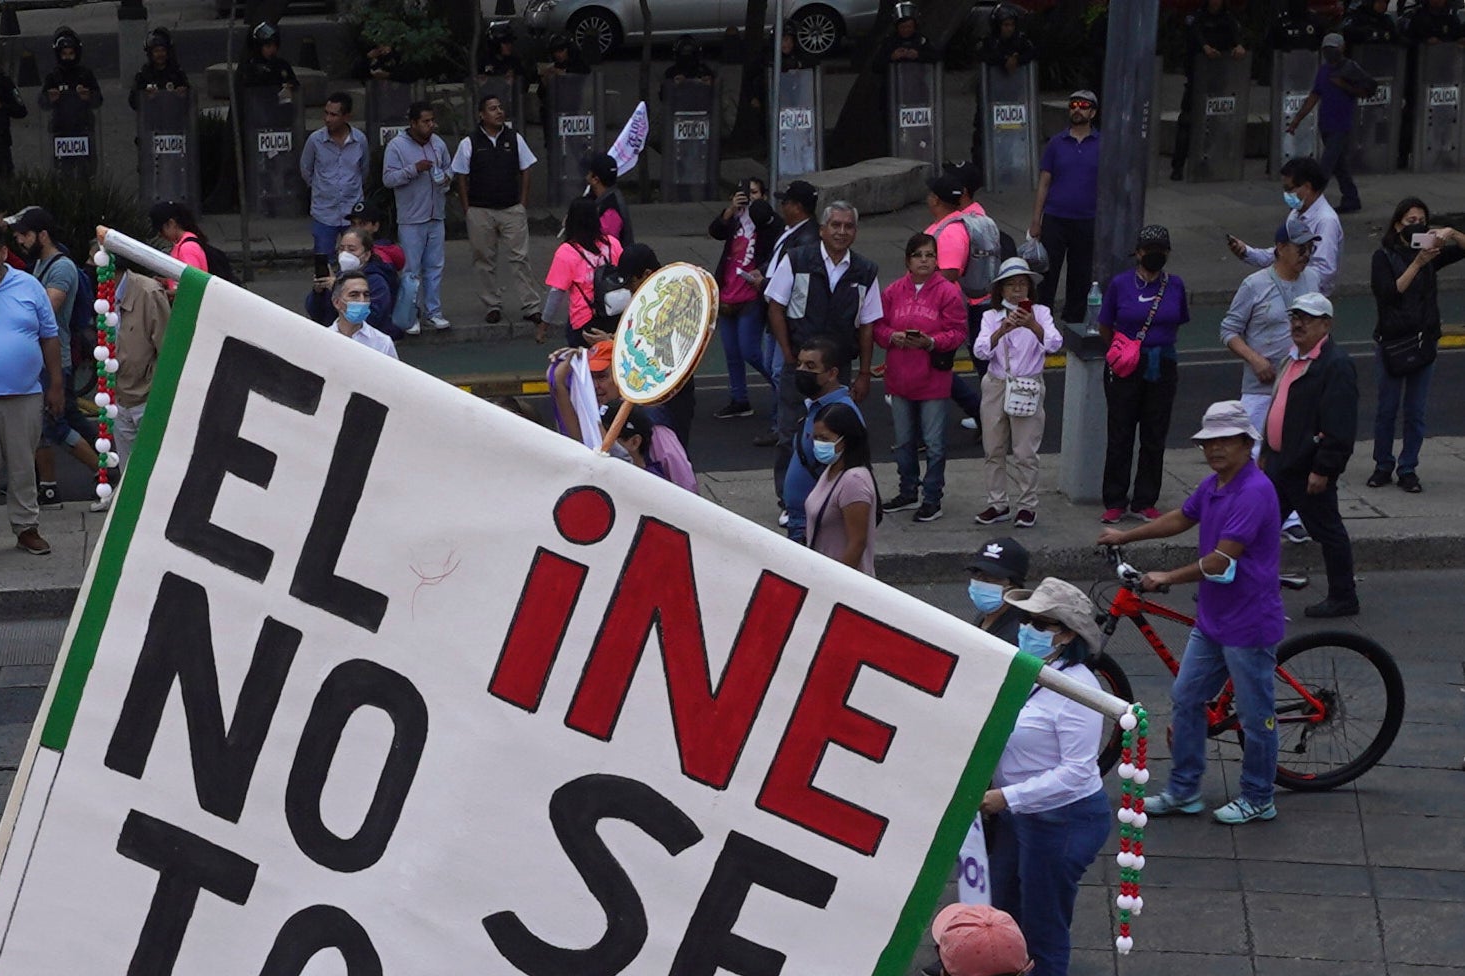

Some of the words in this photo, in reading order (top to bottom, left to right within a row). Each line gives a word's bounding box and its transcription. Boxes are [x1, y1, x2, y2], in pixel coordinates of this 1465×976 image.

[901, 110, 930, 126] POLICIA
[996, 106, 1025, 122] POLICIA
[562, 118, 591, 133] POLICIA
[678, 122, 706, 137] POLICIA
[56, 139, 87, 155] POLICIA
[261, 133, 291, 150] POLICIA
[166, 336, 389, 633] EL
[104, 571, 428, 873] NO
